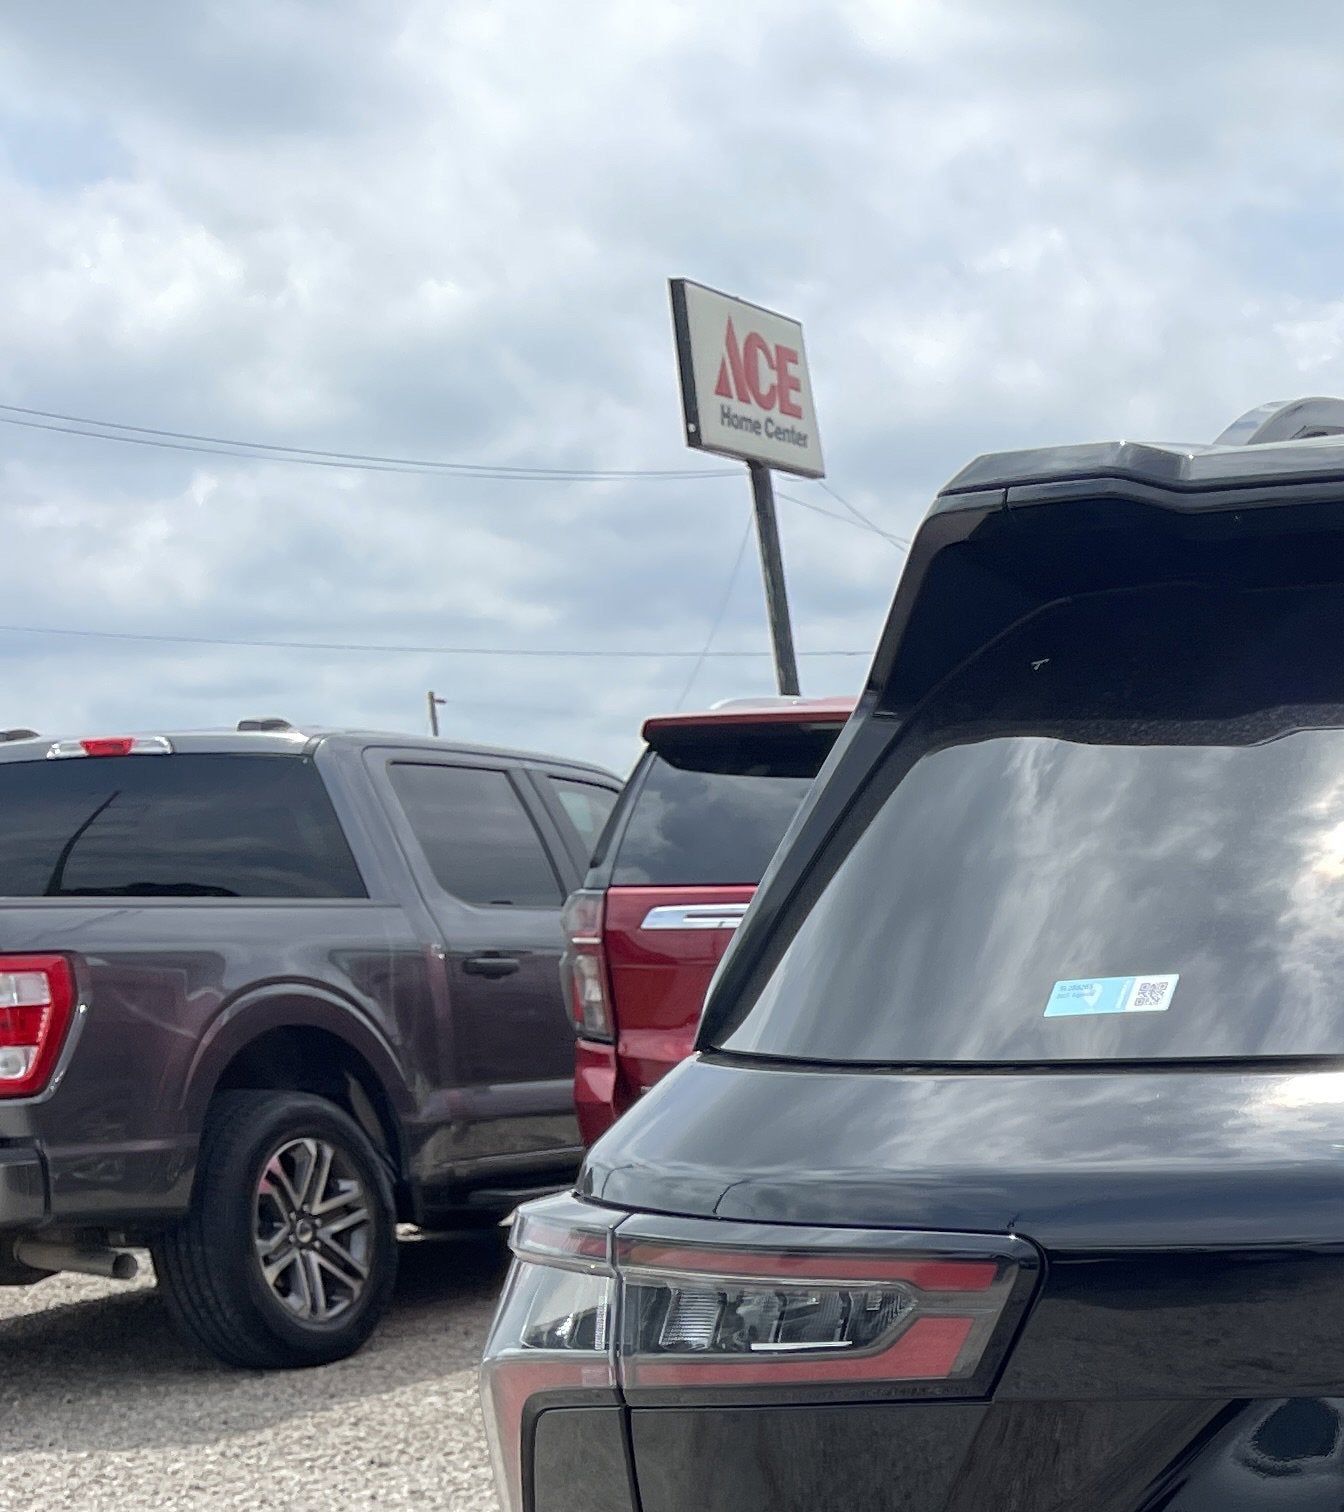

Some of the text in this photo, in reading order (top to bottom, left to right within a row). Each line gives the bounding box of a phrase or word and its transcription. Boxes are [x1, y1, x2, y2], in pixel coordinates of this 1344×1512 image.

[714, 314, 803, 420] ACE
[720, 403, 808, 449] Home Center
